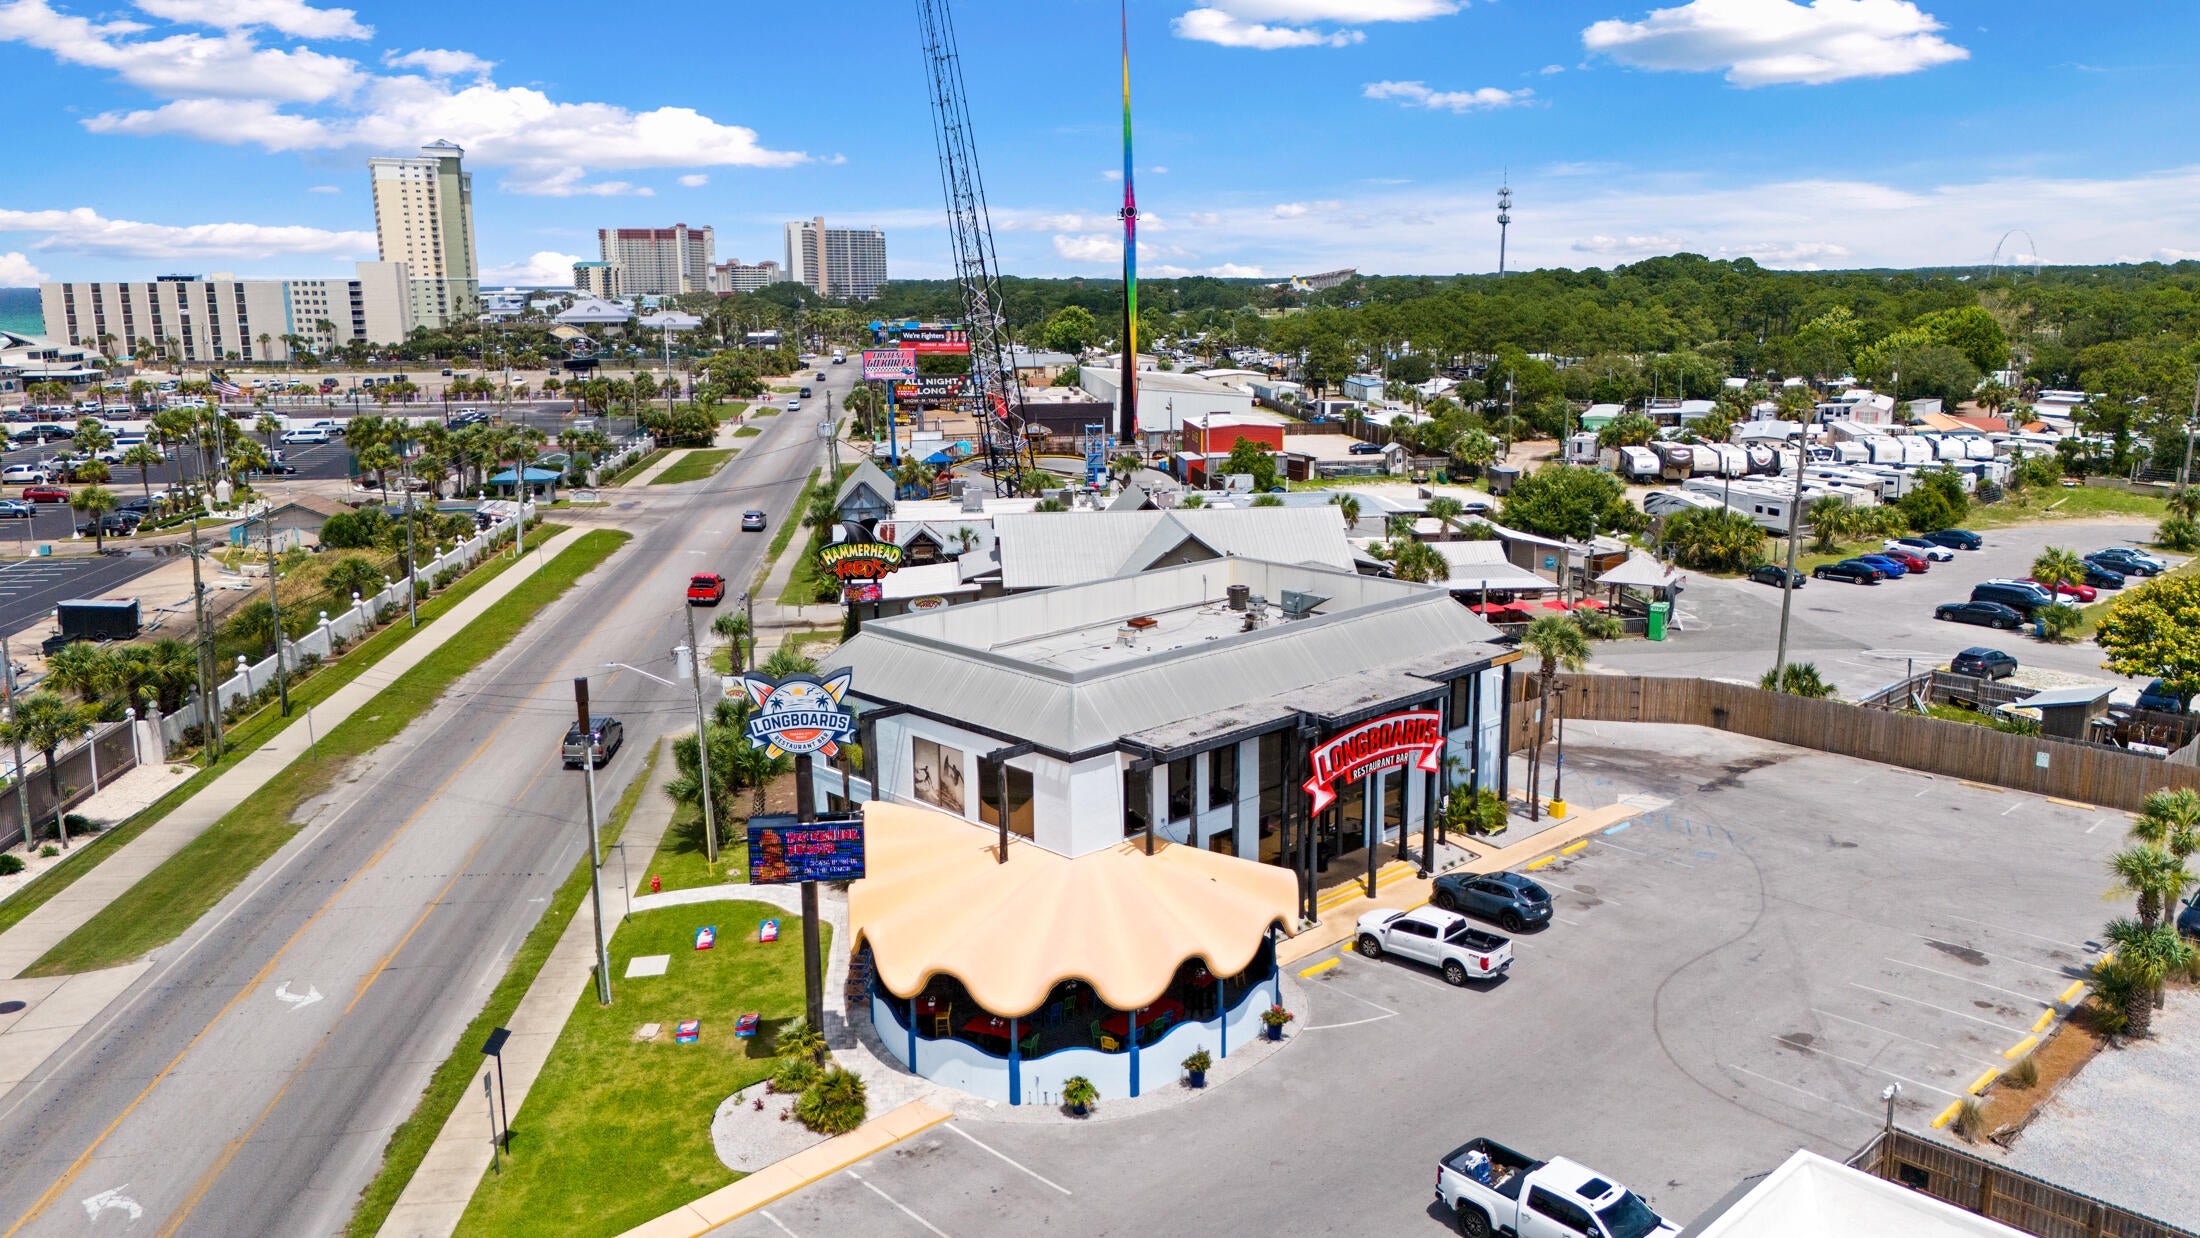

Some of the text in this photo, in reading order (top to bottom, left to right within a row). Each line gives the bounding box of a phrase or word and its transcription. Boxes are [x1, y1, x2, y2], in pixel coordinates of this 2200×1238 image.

[921, 332, 945, 340] Fighters
[866, 359, 912, 368] GO KARTS
[904, 378, 959, 386] ALL NIGHT
[917, 387, 947, 395] LONG
[821, 543, 900, 566] HAMMERHEAD
[835, 558, 887, 580] FRED'S
[753, 713, 848, 734] LONGBOARDS
[774, 735, 816, 750] RESTAURANT
[817, 732, 829, 744] BAR
[1319, 719, 1439, 781] LONGBOARDS
[1353, 752, 1409, 780] RESTAURANT BAR
